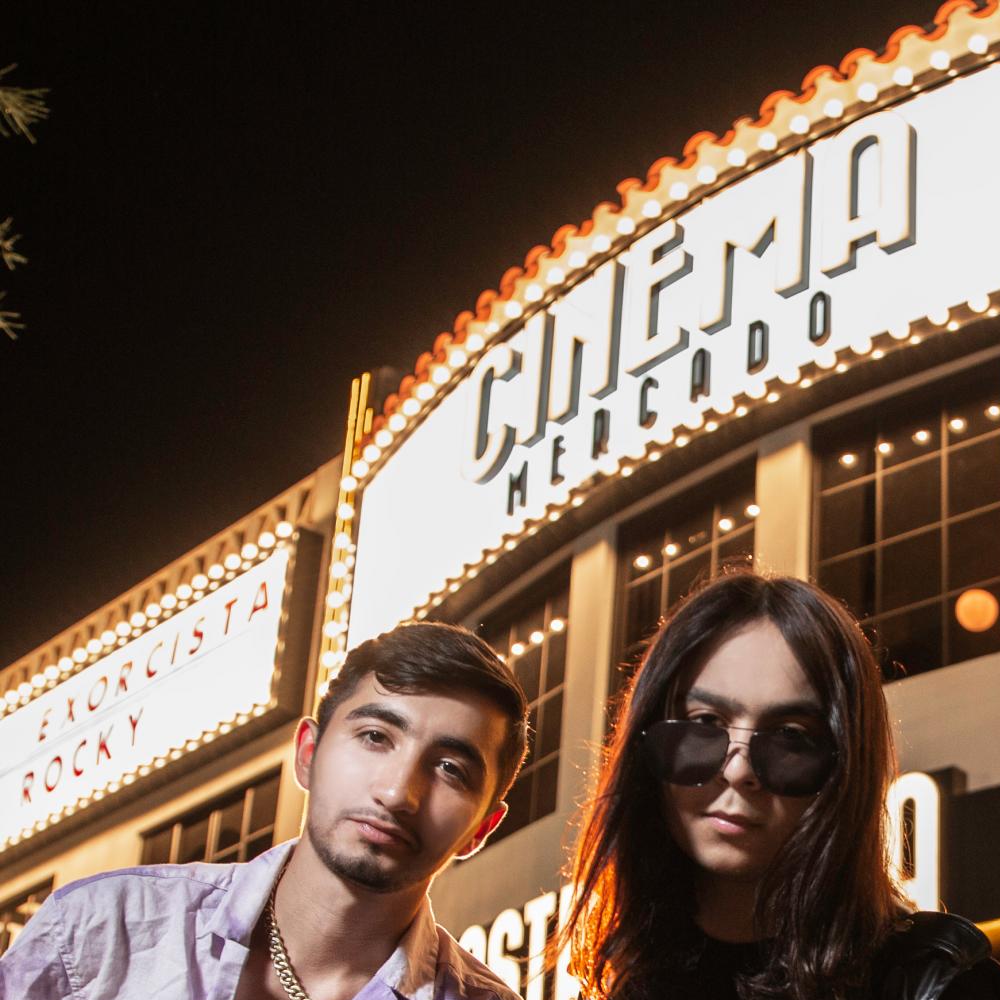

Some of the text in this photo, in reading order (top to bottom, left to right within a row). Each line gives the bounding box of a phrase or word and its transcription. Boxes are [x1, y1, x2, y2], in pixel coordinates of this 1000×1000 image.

[460, 112, 917, 484] CINEMA
[507, 291, 831, 515] MERCADO
[21, 706, 143, 803] ROCKY
[38, 581, 268, 742] EXORCISTA
